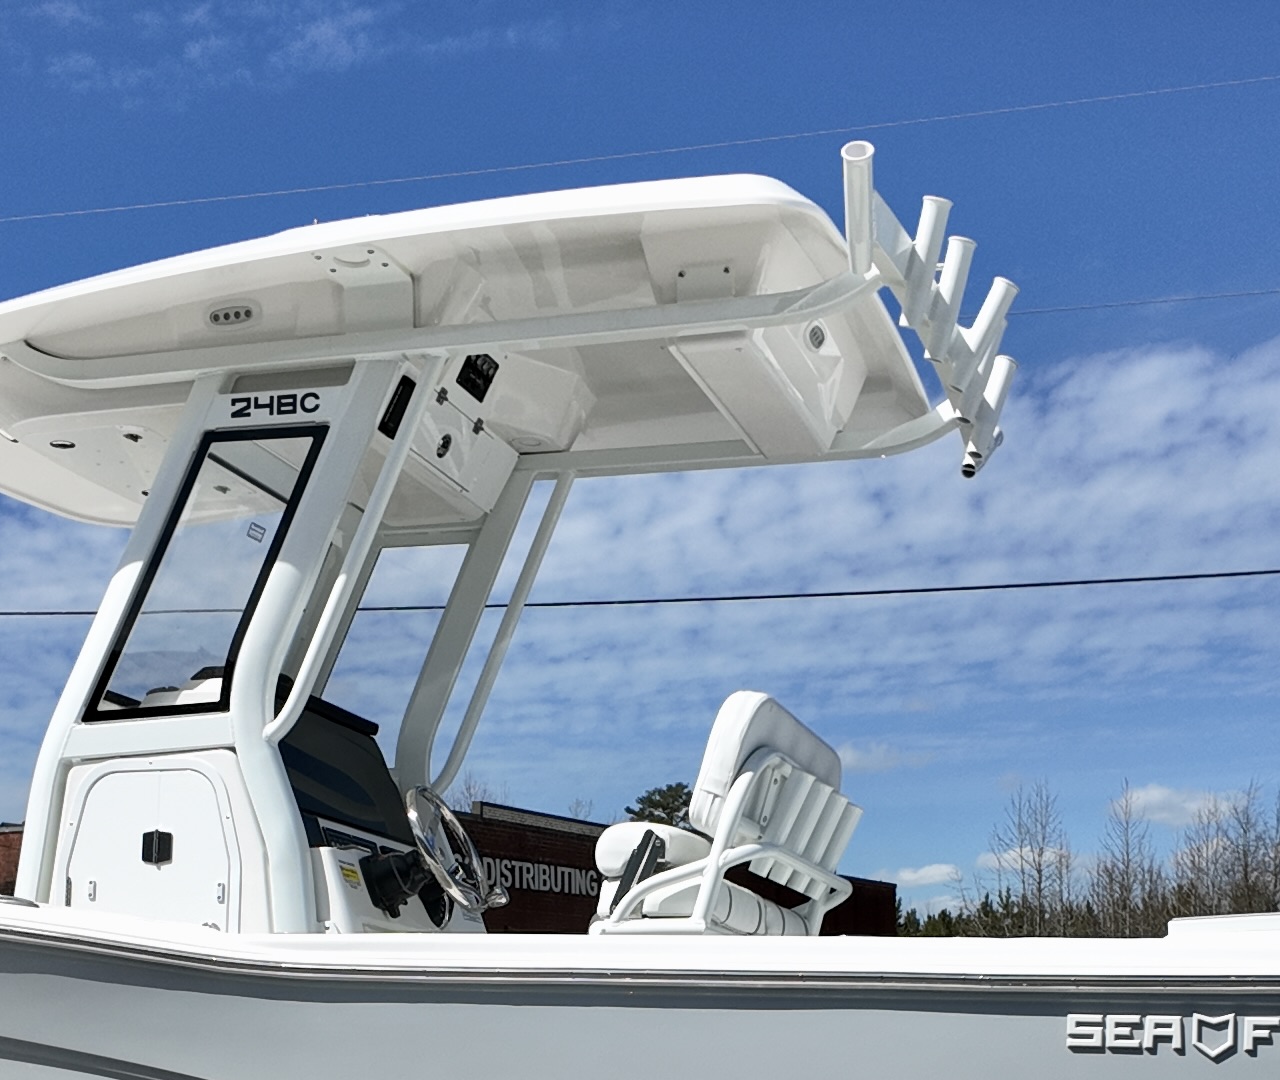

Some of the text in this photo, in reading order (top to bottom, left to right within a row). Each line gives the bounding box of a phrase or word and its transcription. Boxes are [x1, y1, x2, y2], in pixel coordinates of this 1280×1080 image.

[230, 392, 320, 418] 248C
[482, 856, 599, 897] DISTRIBUTING
[1066, 1014, 1184, 1053] SEA
